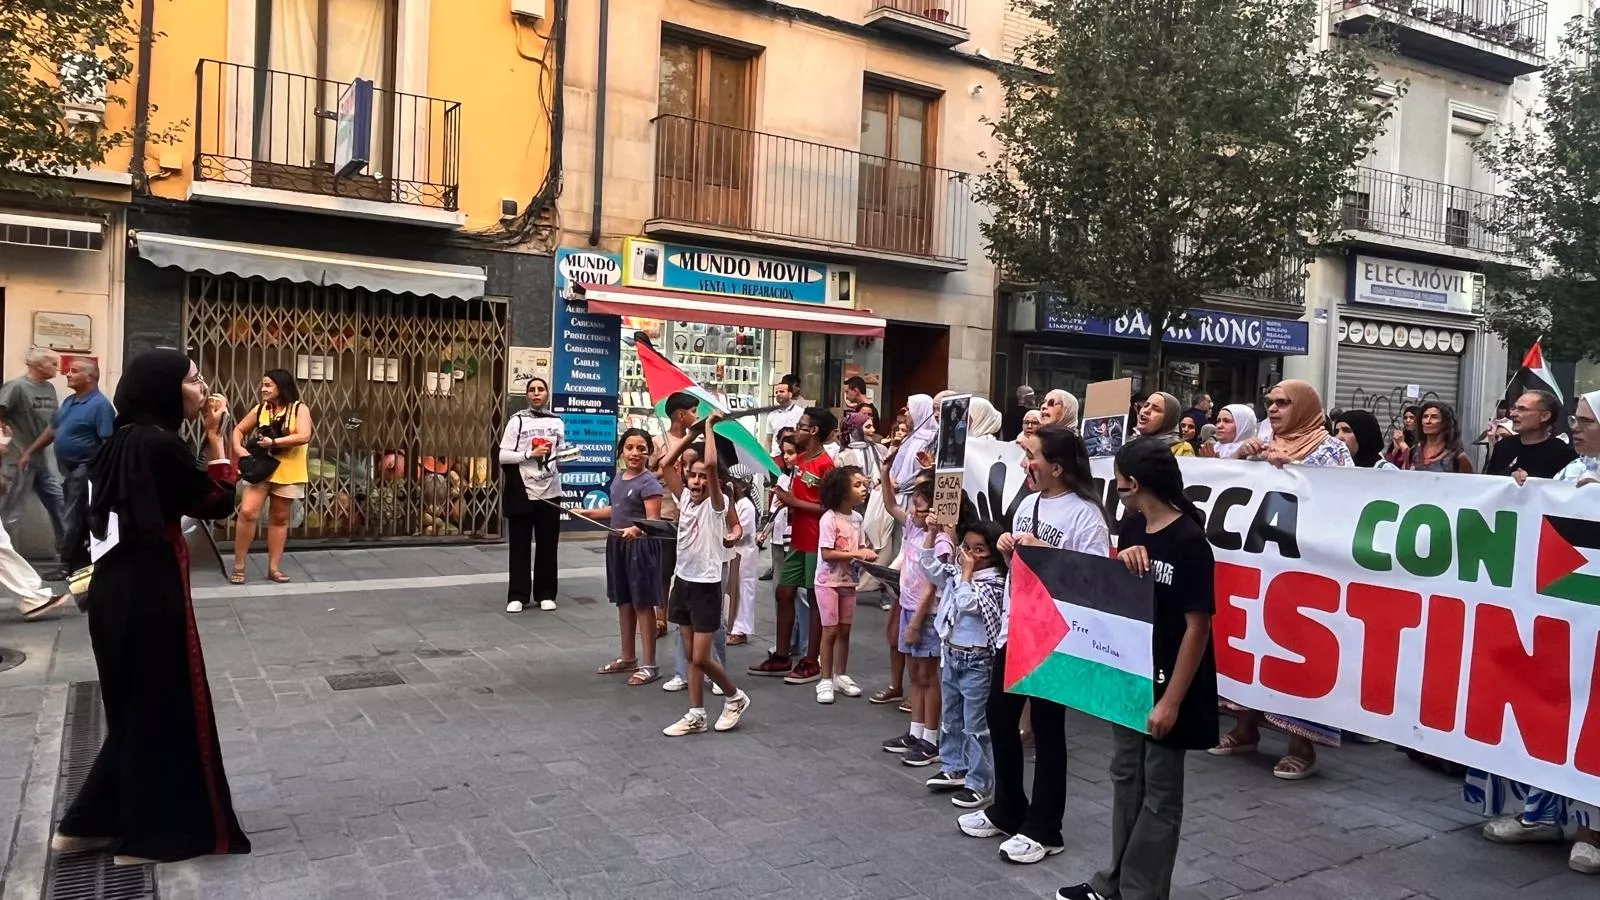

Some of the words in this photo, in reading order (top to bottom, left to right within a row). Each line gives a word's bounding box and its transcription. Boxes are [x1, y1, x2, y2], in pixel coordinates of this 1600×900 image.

[565, 254, 616, 272] MUNDO
[679, 251, 751, 277] MUNDO
[757, 260, 814, 284] MOVIL
[1364, 262, 1468, 294] ELEC-MÓVIL
[699, 279, 727, 293] VENTA
[732, 283, 738, 294] Y
[573, 357, 600, 368] CABLES
[568, 396, 602, 407] HORARIO
[937, 476, 961, 489] GAZA
[937, 502, 958, 516] FOTO
[1352, 499, 1518, 588] CON
